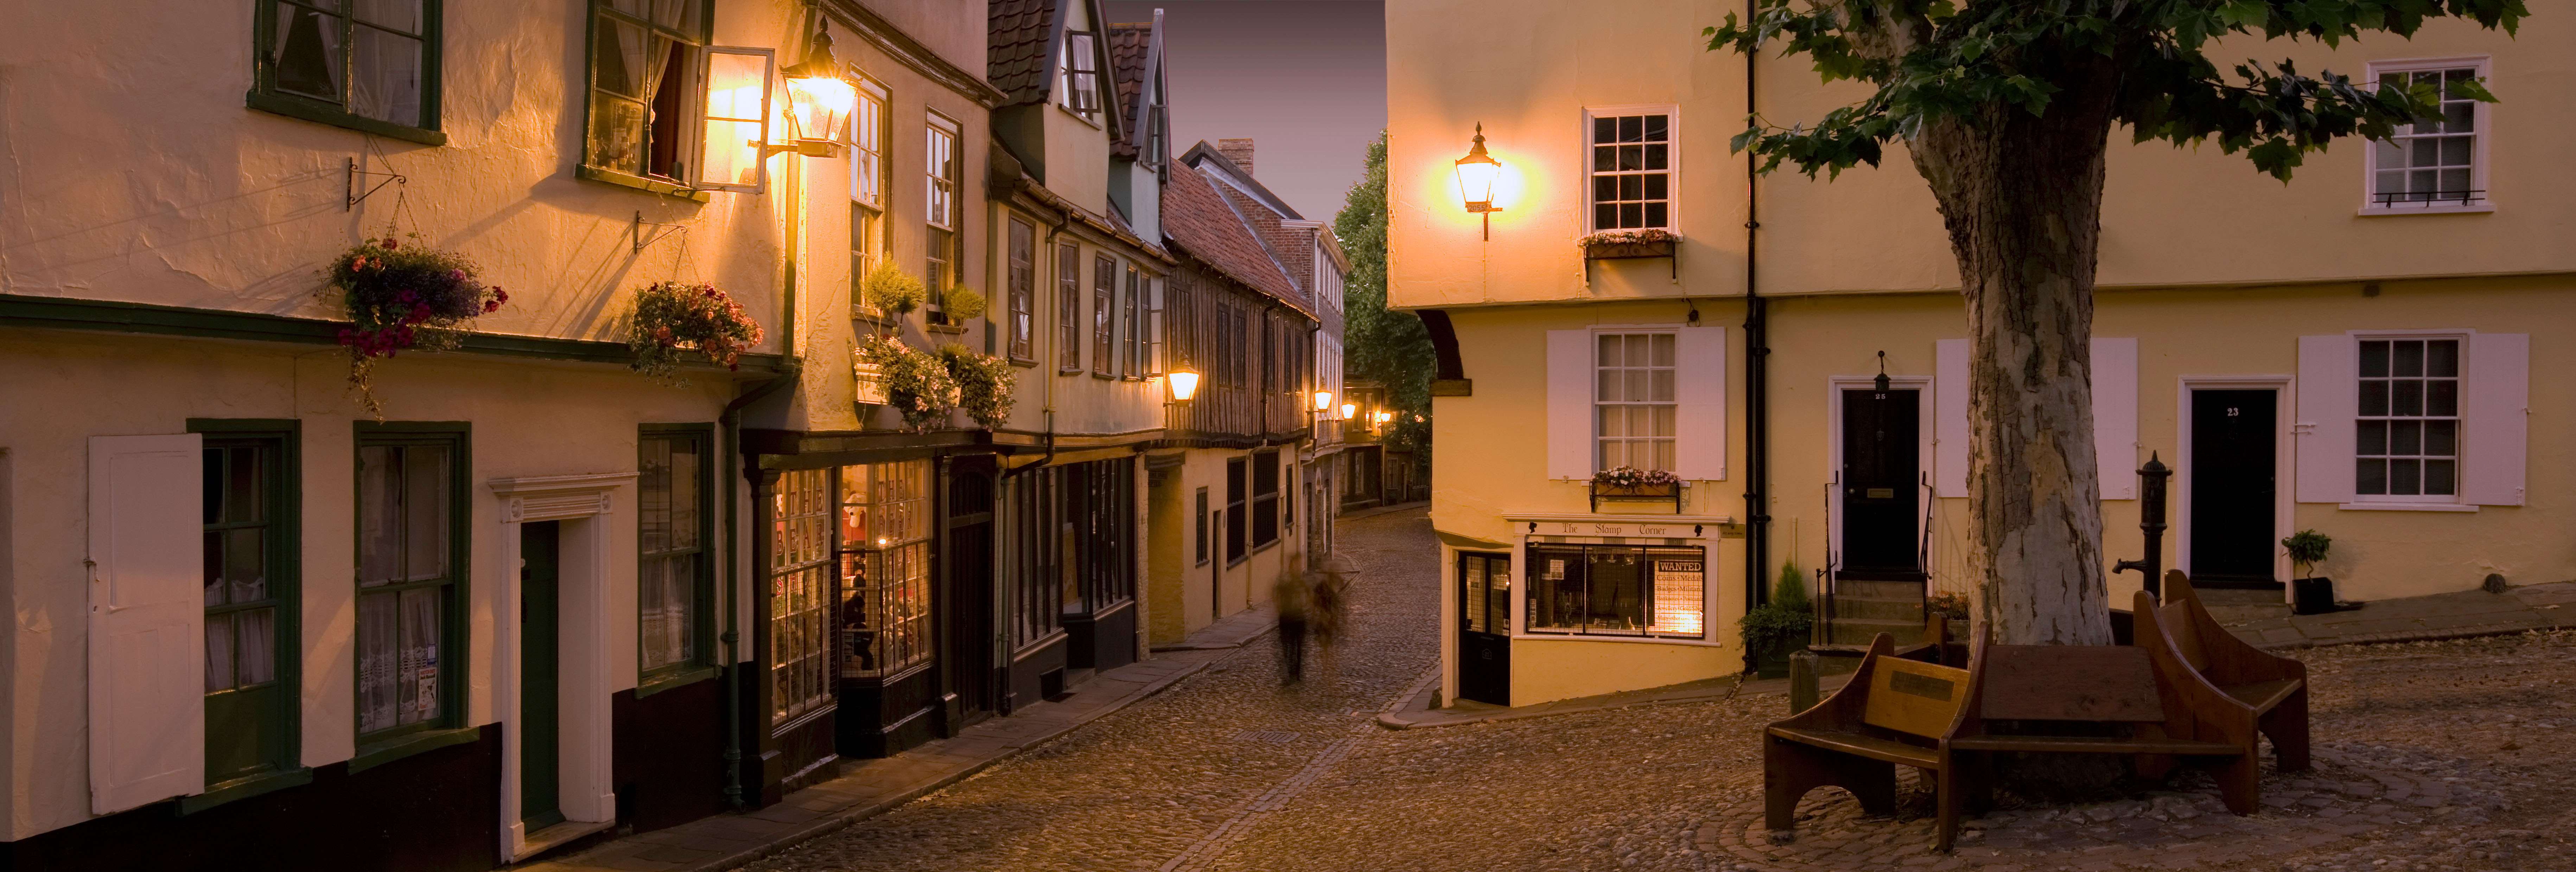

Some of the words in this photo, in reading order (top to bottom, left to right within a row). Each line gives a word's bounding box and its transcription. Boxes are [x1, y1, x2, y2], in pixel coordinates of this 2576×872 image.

[2227, 407, 2239, 416] 23
[879, 479, 903, 502] THE
[791, 488, 824, 515] THE
[776, 522, 824, 556] BEAR
[1562, 522, 1578, 533] The
[1595, 522, 1621, 536] Stamp
[1637, 523, 1666, 537] Corner
[1660, 563, 1701, 571] WANTED
